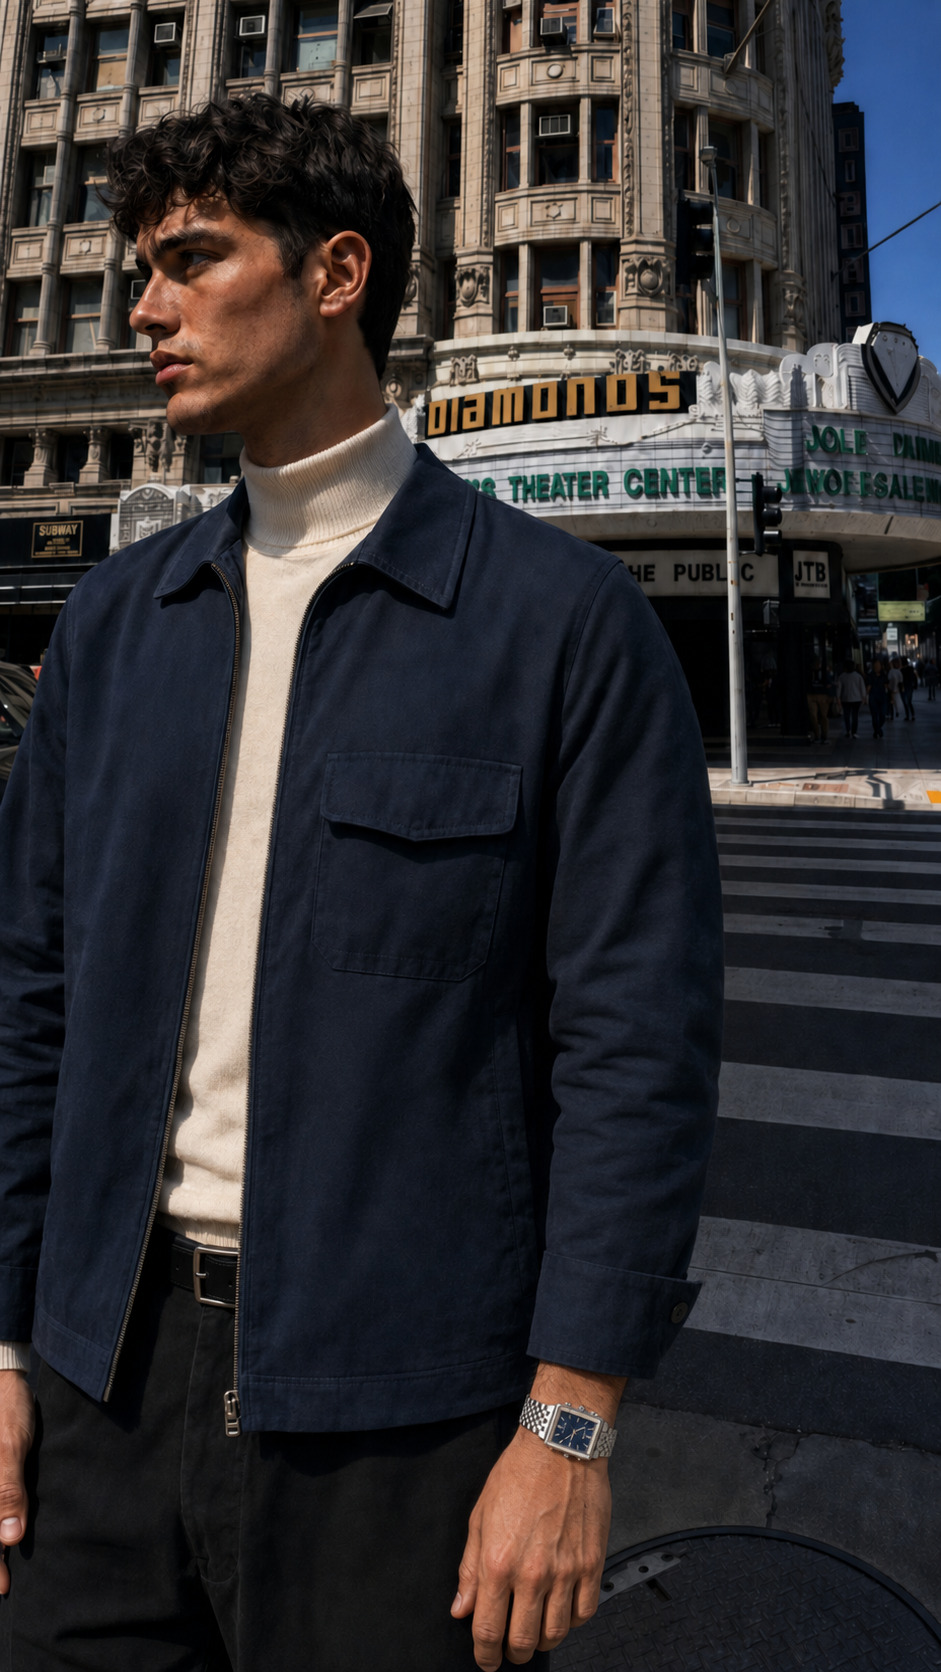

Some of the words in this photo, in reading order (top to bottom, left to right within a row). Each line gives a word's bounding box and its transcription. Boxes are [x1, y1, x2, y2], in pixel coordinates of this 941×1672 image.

[508, 470, 609, 503] THEATER
[623, 467, 727, 499] CENTER
[39, 524, 78, 536] SUBWAY
[628, 563, 656, 582] HE
[673, 563, 755, 582] PUBLC
[795, 561, 826, 582] JTB
